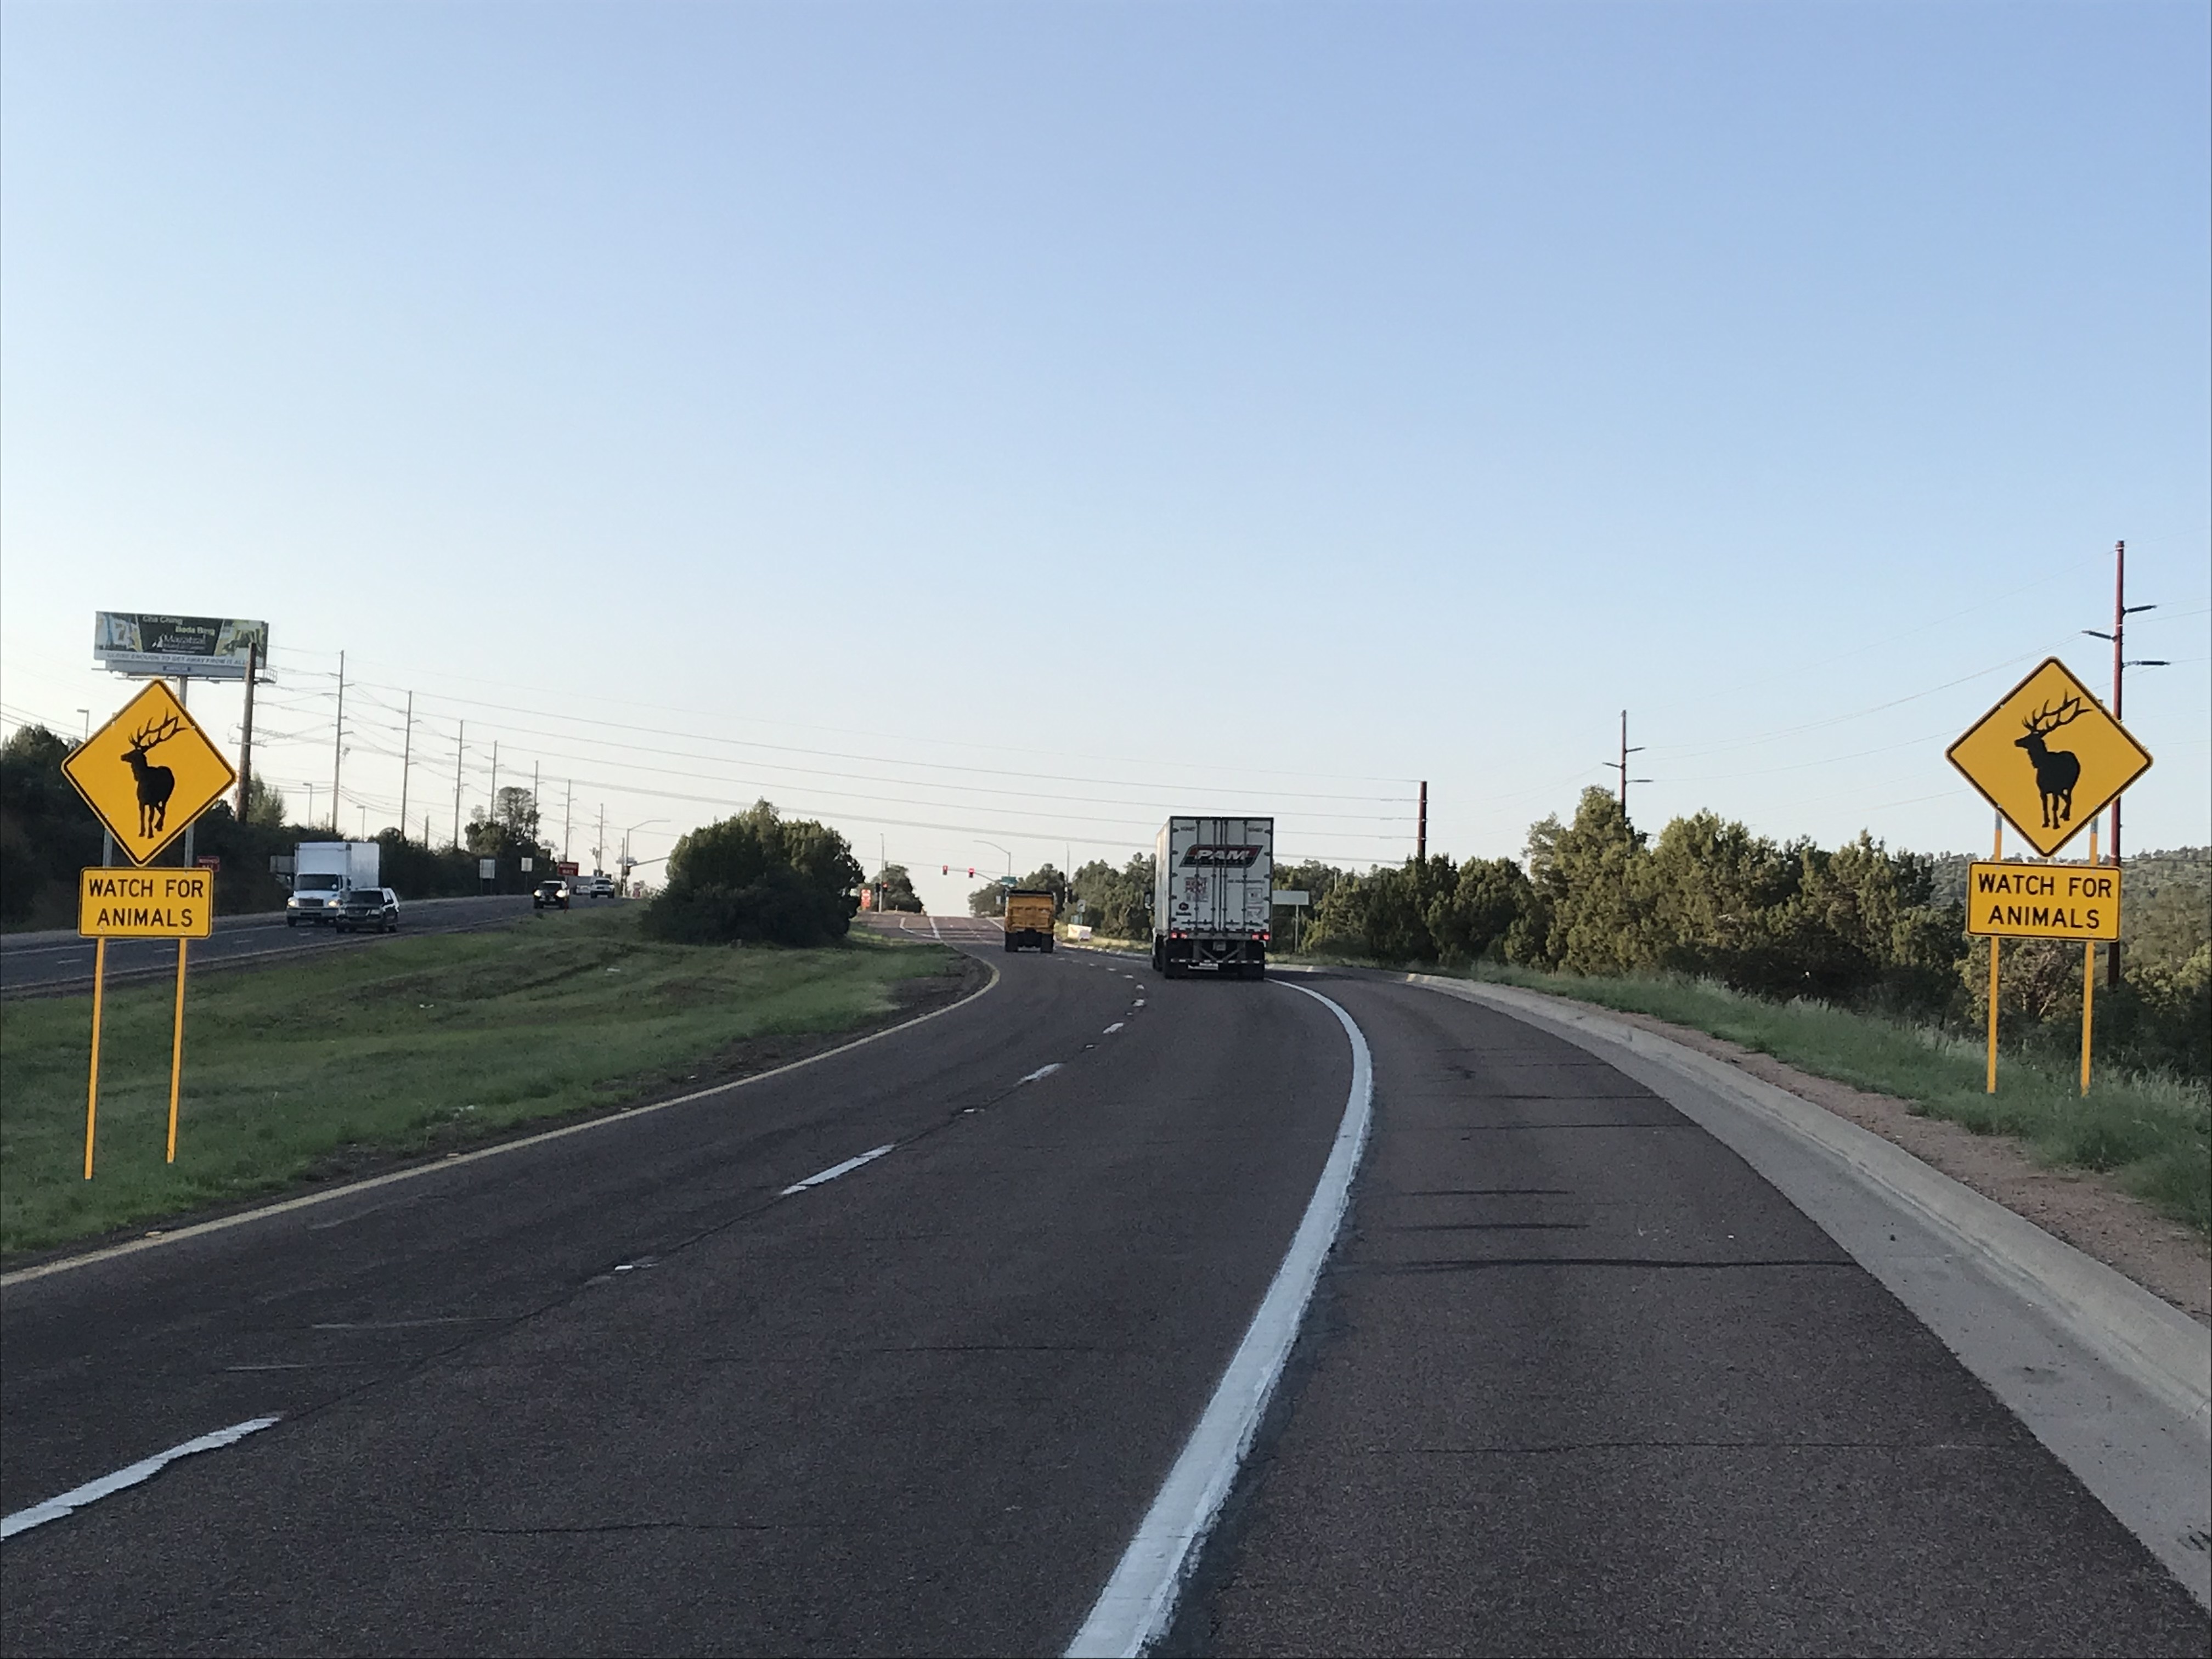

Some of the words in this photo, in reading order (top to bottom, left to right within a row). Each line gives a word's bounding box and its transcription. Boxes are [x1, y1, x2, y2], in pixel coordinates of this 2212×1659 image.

[89, 878, 154, 898] WATCH
[166, 879, 204, 898] FOR
[1978, 873, 2054, 895] WATCH
[2069, 877, 2112, 898] FOR
[97, 908, 193, 927] ANIMALS
[1988, 905, 2100, 929] ANIMALS
